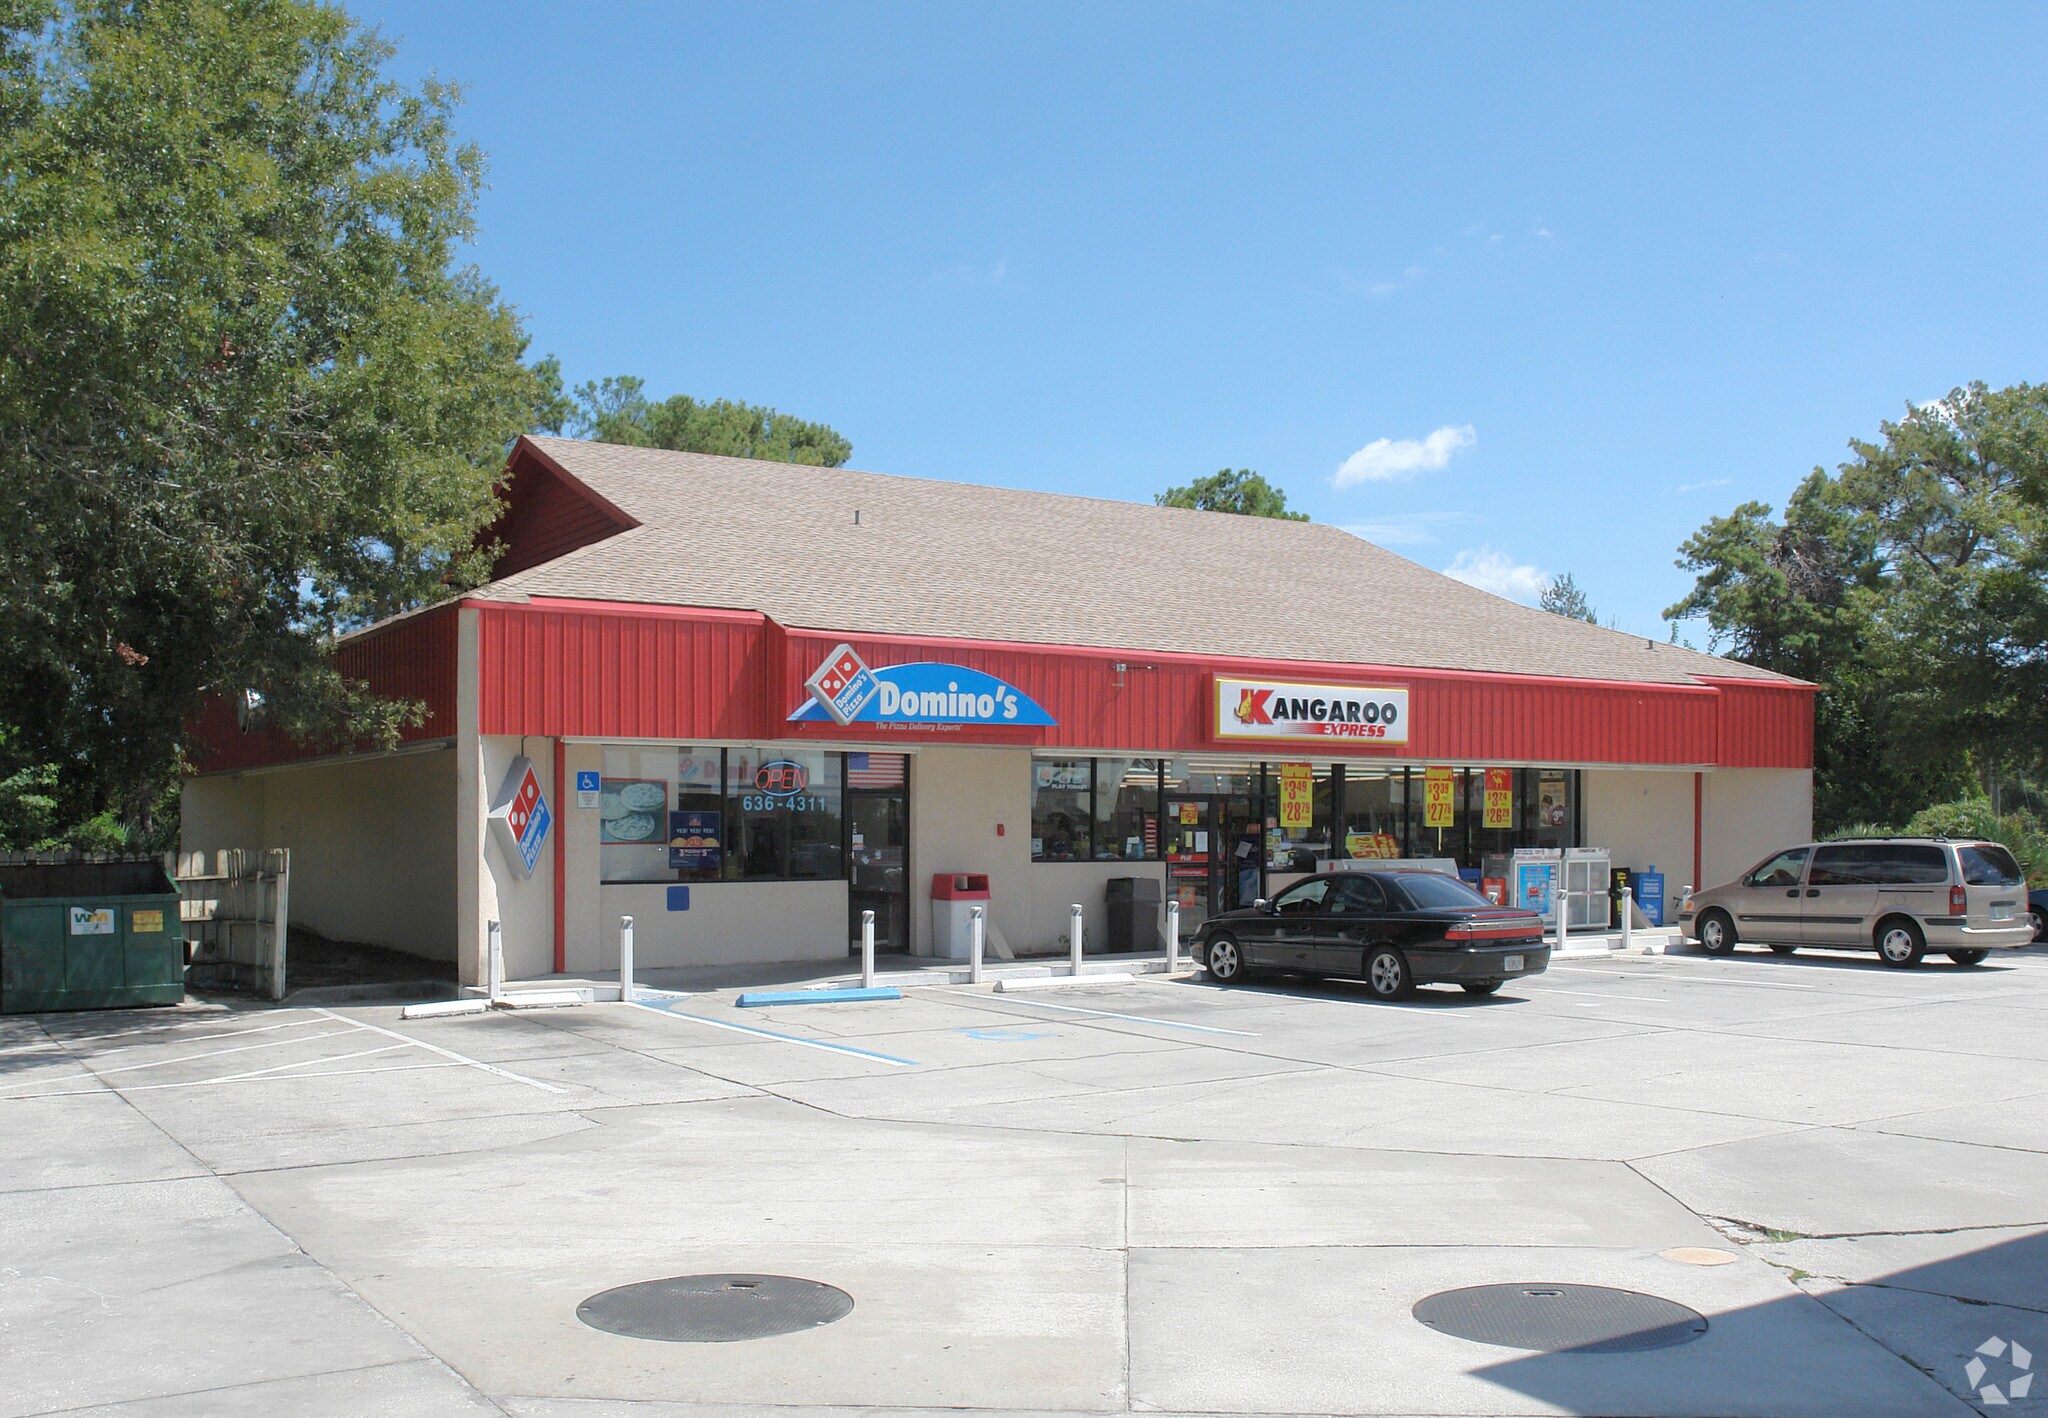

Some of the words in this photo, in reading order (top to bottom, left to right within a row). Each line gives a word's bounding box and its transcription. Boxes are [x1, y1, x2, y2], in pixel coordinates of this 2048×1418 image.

[835, 672, 868, 709] Domino's
[880, 681, 1018, 719] Domino's
[843, 691, 865, 718] Pizza
[1240, 688, 1398, 725] KANGAROO
[875, 721, 888, 731] The
[888, 721, 907, 731] Pizza
[908, 722, 935, 732] Delivery
[936, 723, 962, 732] Experts
[1323, 723, 1387, 738] EXPRESS
[755, 768, 808, 790] OPEN
[742, 796, 826, 811] 636-4311
